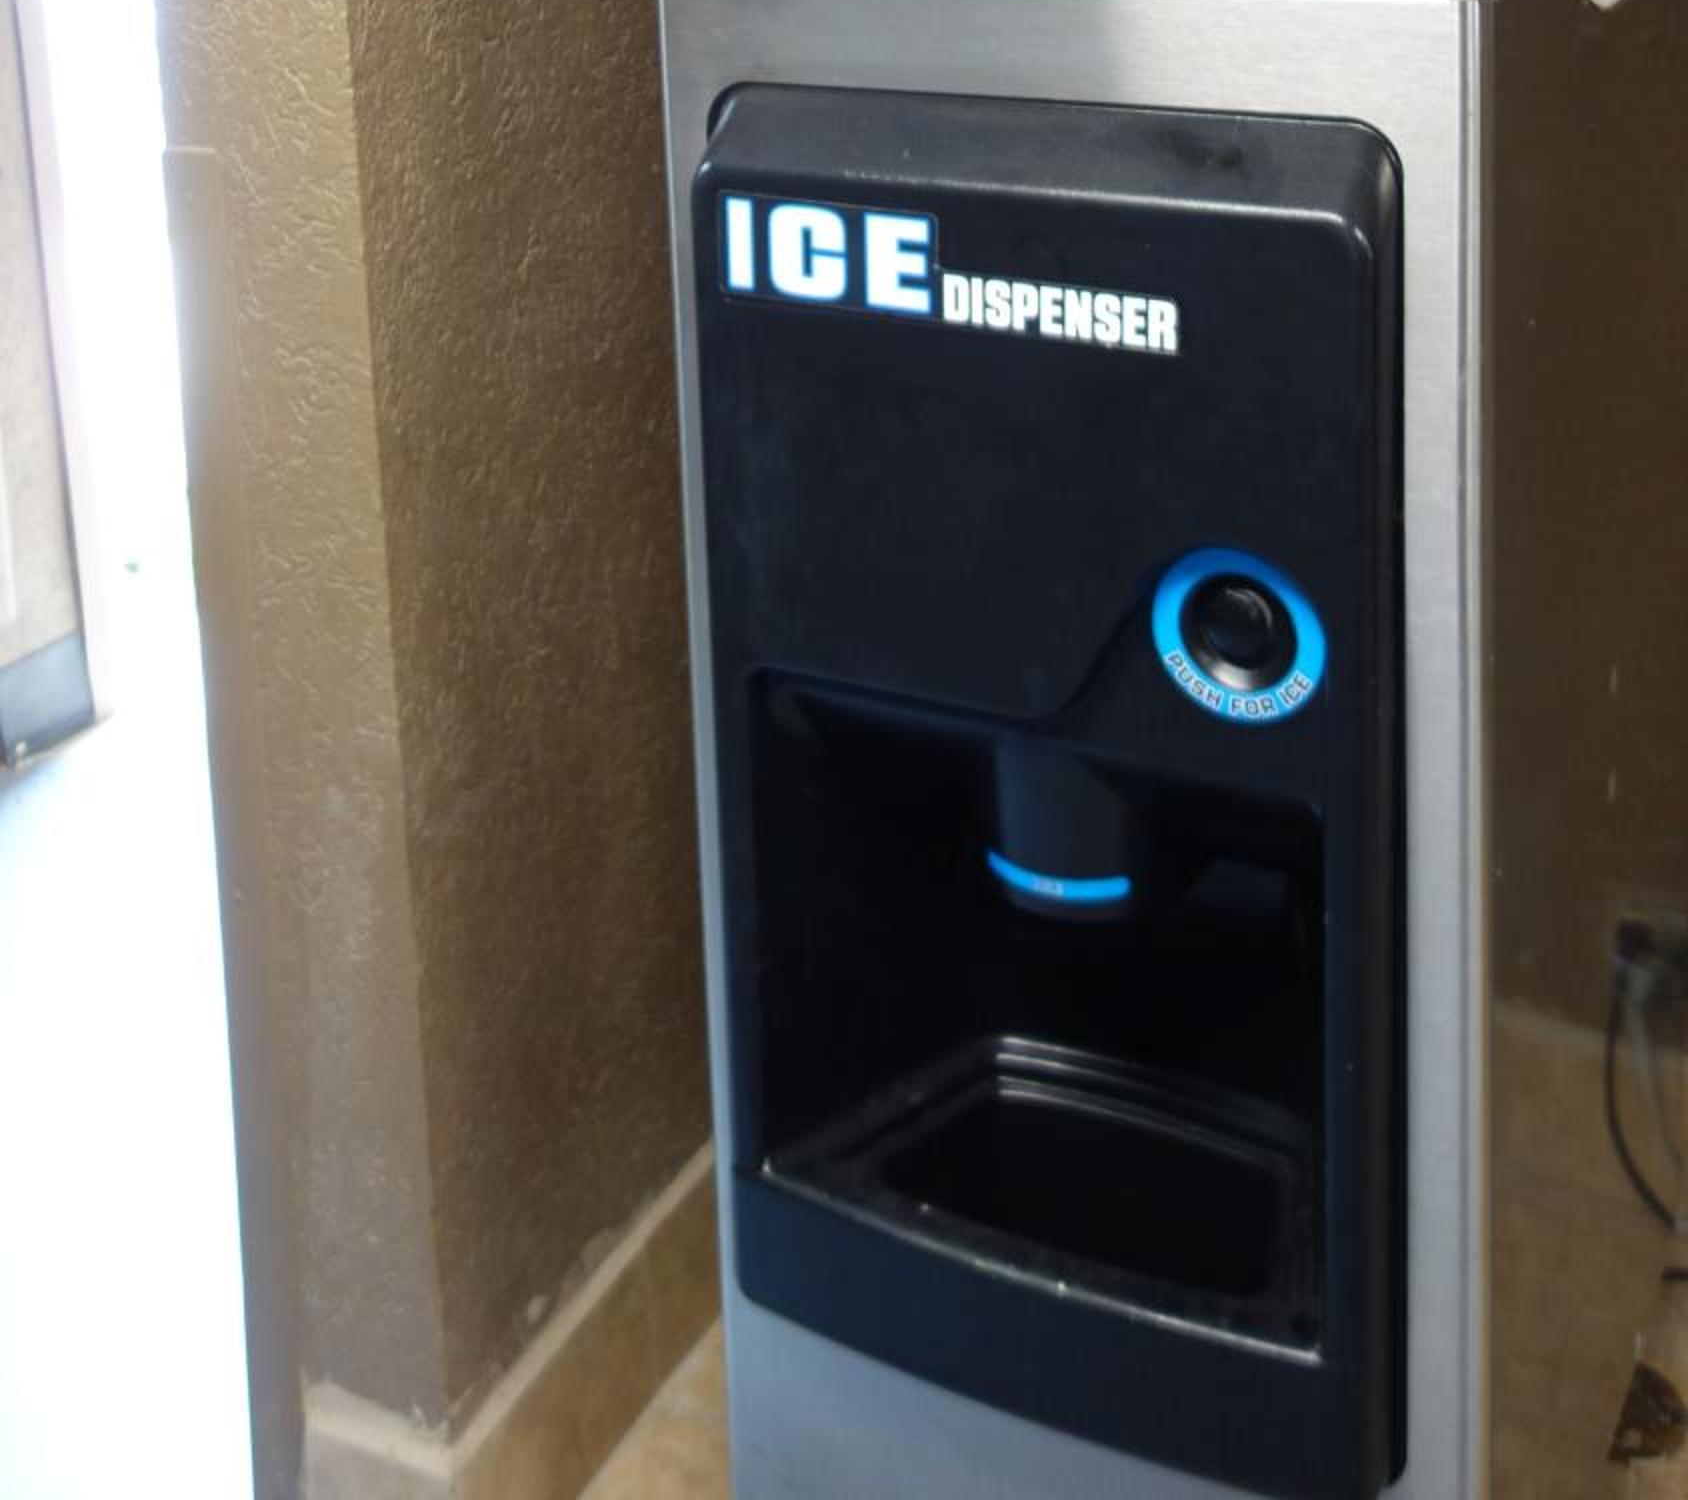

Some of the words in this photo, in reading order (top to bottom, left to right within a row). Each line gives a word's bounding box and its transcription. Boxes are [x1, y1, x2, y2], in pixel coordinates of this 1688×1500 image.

[725, 197, 931, 313] ICE
[942, 273, 1178, 351] DISPENSER
[1167, 652, 1223, 709] PUSH
[1231, 697, 1277, 716] FOR
[1278, 673, 1312, 705] ICE
